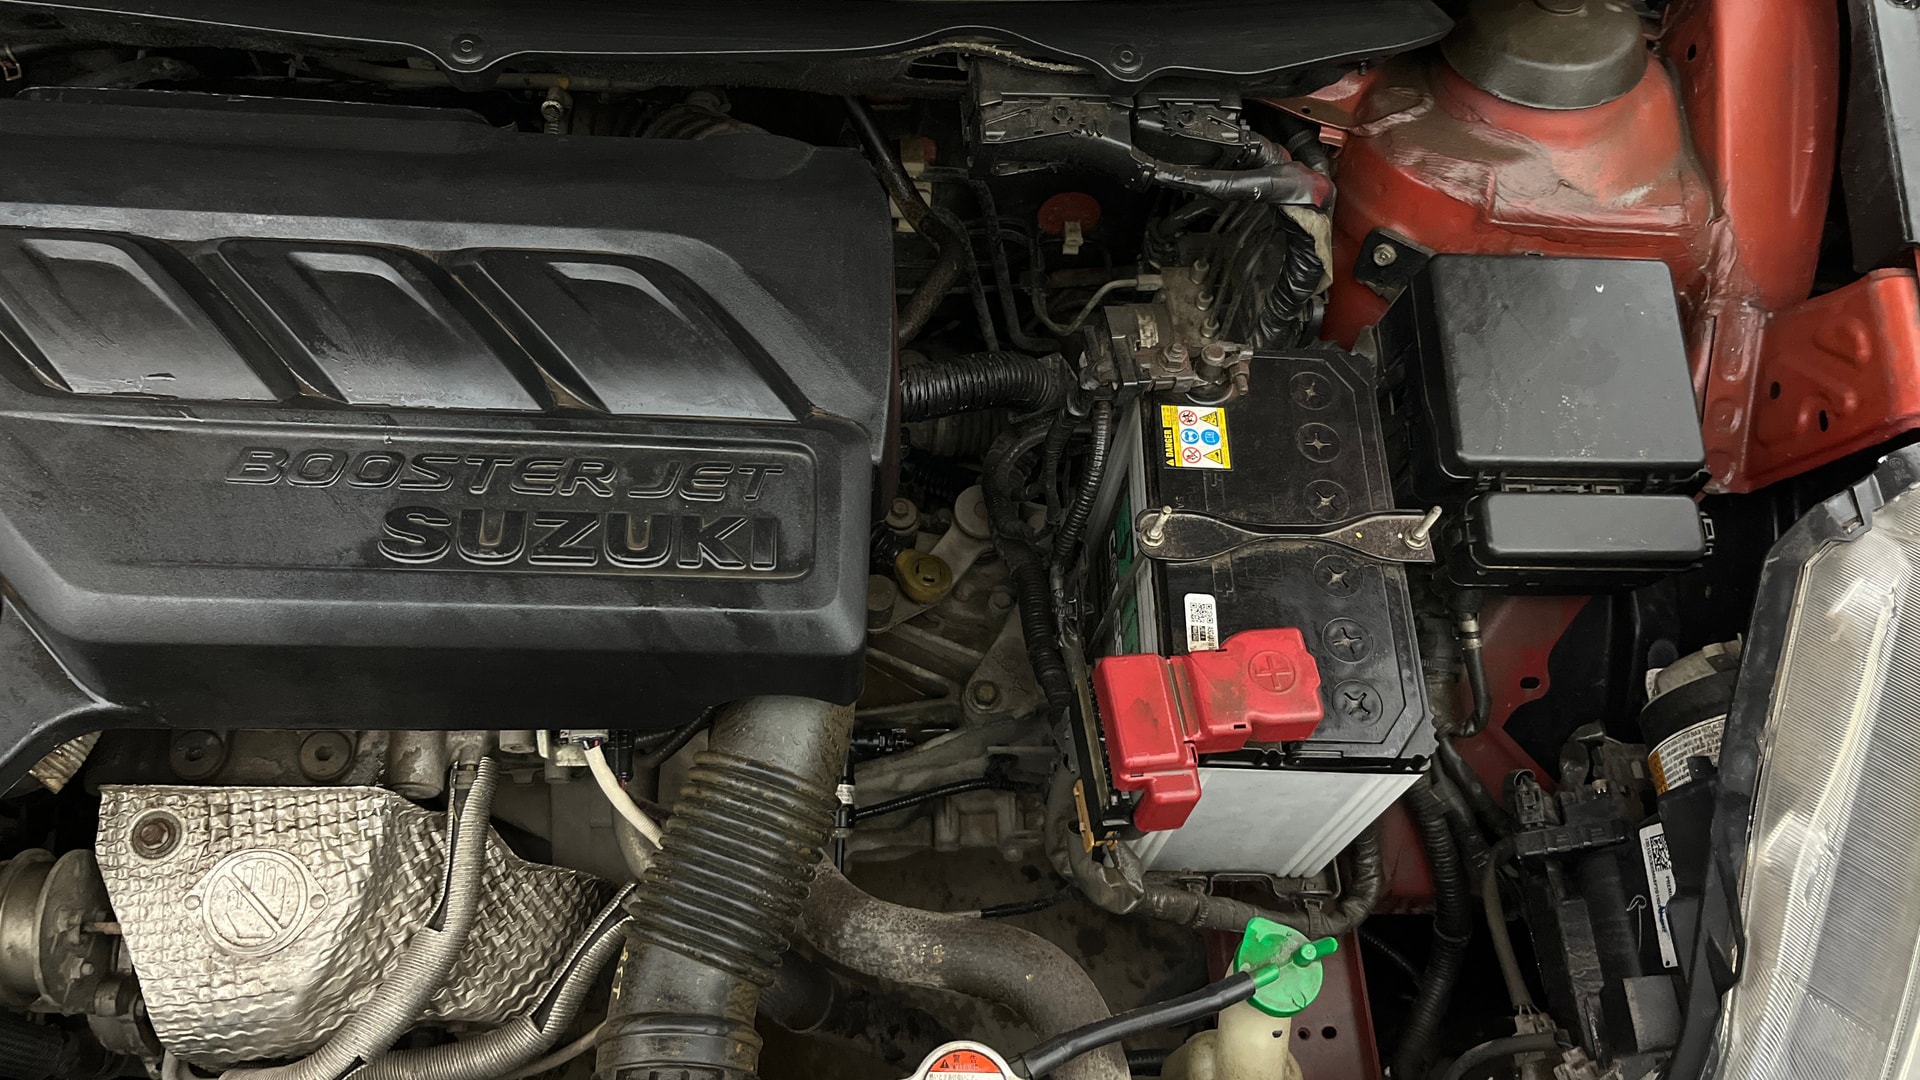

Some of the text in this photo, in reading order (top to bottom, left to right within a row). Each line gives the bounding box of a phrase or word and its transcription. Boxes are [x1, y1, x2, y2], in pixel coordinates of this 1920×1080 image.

[1163, 429, 1174, 457] DANGER
[225, 446, 786, 501] BOOSTER JET
[377, 505, 780, 571] SUZUKI
